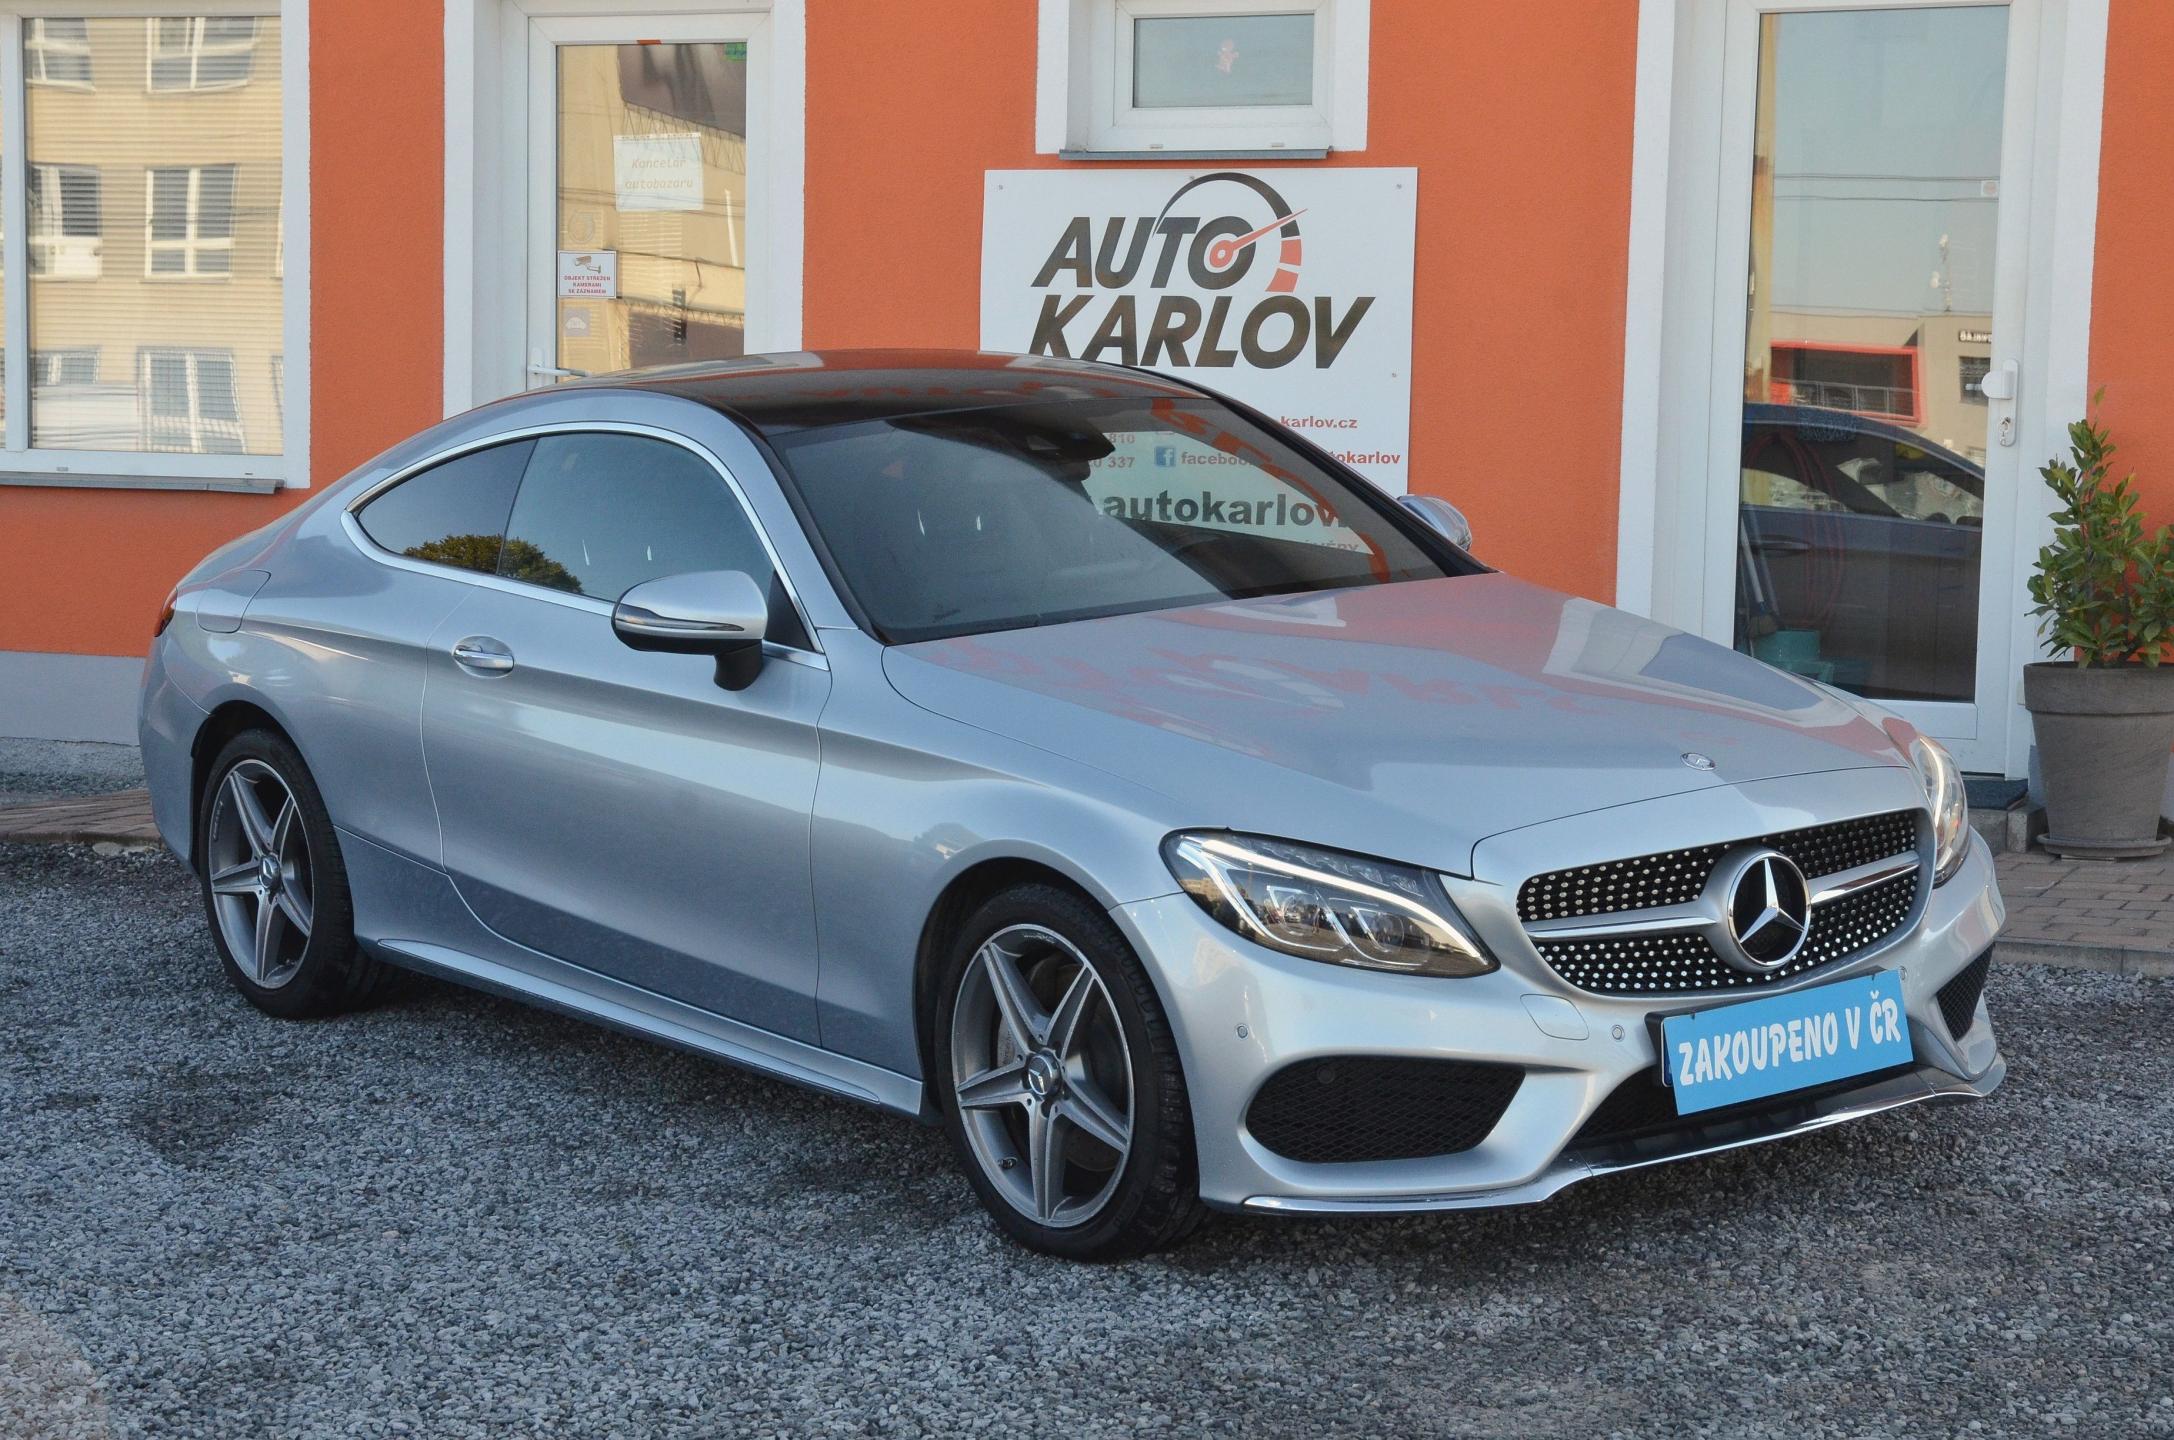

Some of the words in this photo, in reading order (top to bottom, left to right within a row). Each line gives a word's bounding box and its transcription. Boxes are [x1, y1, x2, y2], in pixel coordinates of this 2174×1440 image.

[1030, 215, 1257, 290] AUTO
[1028, 294, 1376, 369] KARLOV
[1679, 1012, 1839, 1086] ZAKOUPENO
[1845, 1006, 1861, 1050] V
[1869, 990, 1901, 1045] ČR
